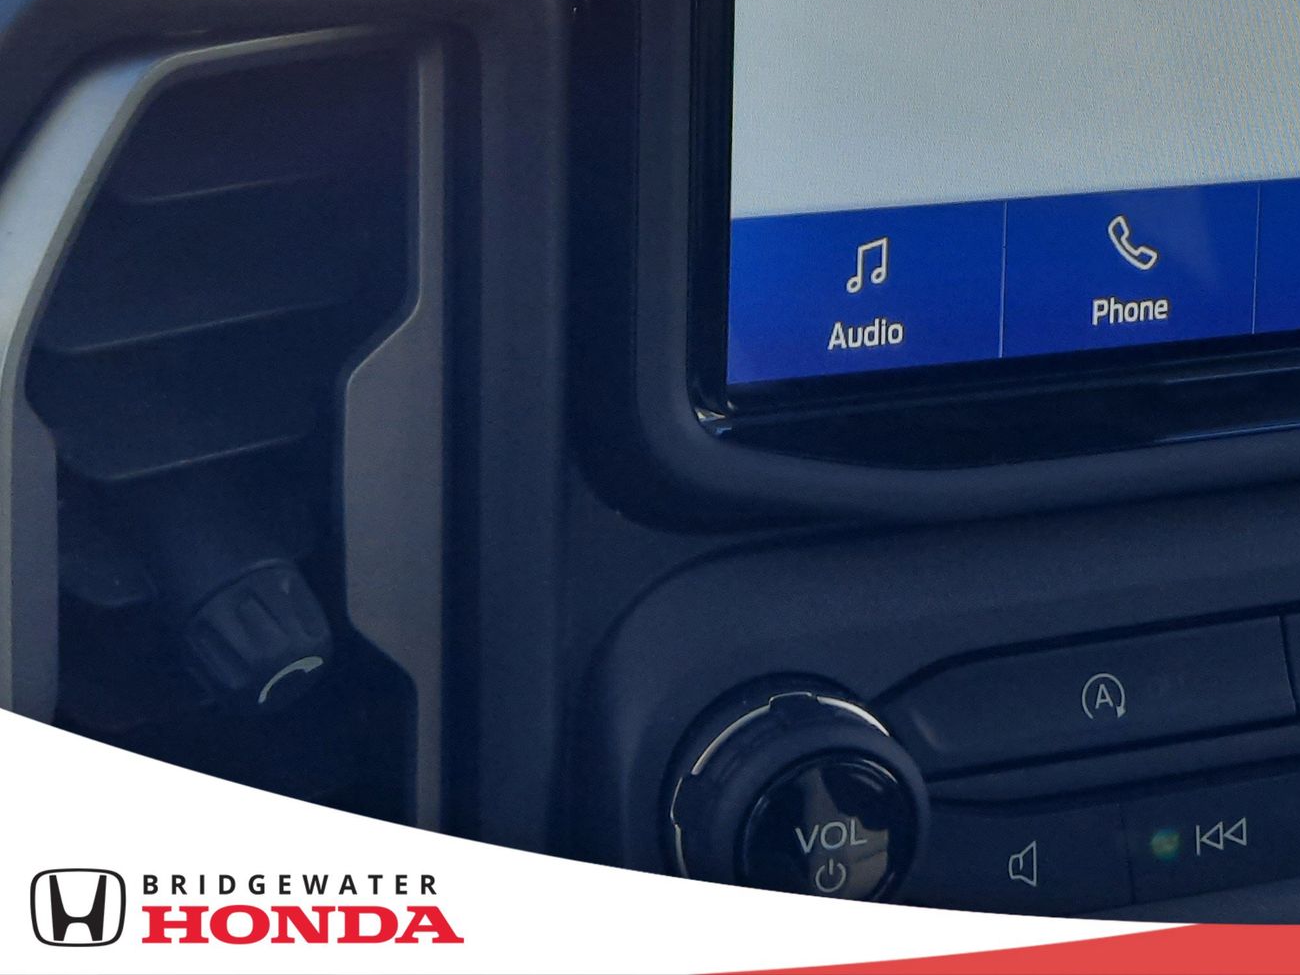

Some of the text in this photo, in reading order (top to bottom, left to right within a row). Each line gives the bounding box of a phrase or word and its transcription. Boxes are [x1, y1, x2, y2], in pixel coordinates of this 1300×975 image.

[1091, 296, 1169, 326] Phone
[828, 319, 905, 351] Audio
[795, 821, 868, 854] VOL
